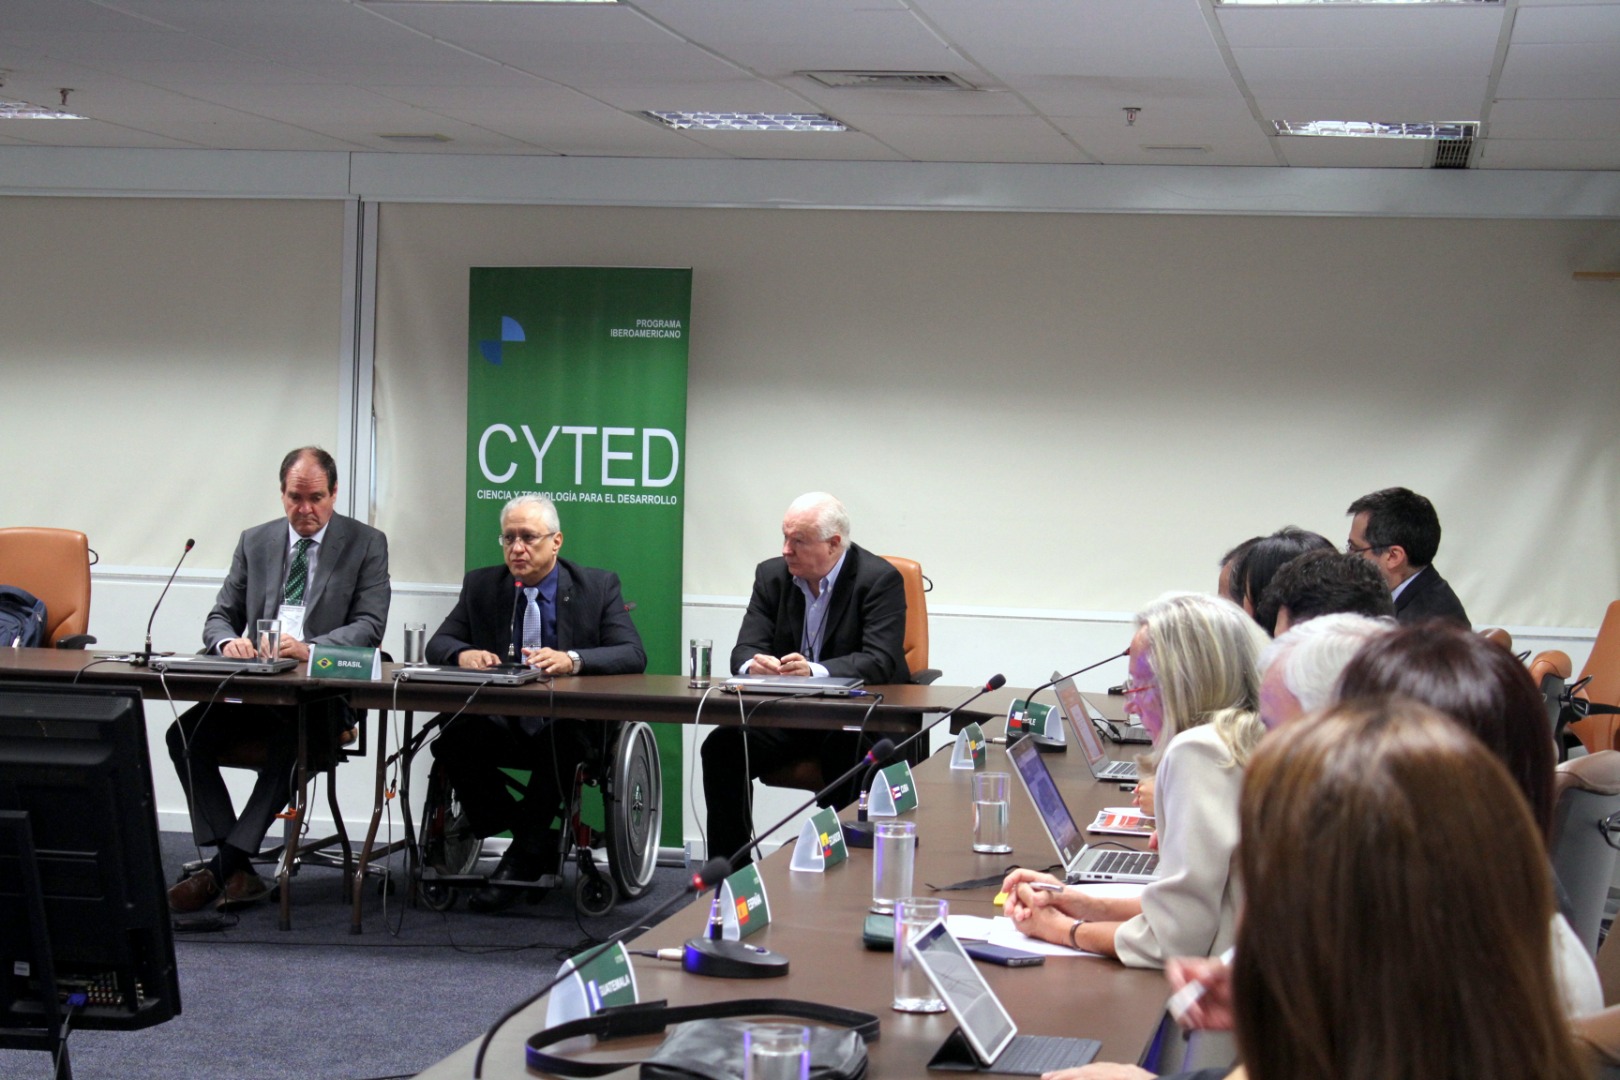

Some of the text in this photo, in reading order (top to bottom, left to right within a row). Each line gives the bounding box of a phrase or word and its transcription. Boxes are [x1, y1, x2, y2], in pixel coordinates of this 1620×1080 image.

[636, 319, 681, 328] PROGRAMA
[610, 328, 681, 338] IBEROAMERICANO
[478, 423, 680, 488] CYTED
[476, 489, 512, 500] CIENCIA
[579, 492, 603, 502] PARA
[605, 493, 616, 503] EL
[618, 494, 677, 505] DESARROLLO
[337, 660, 363, 668] BRASIL
